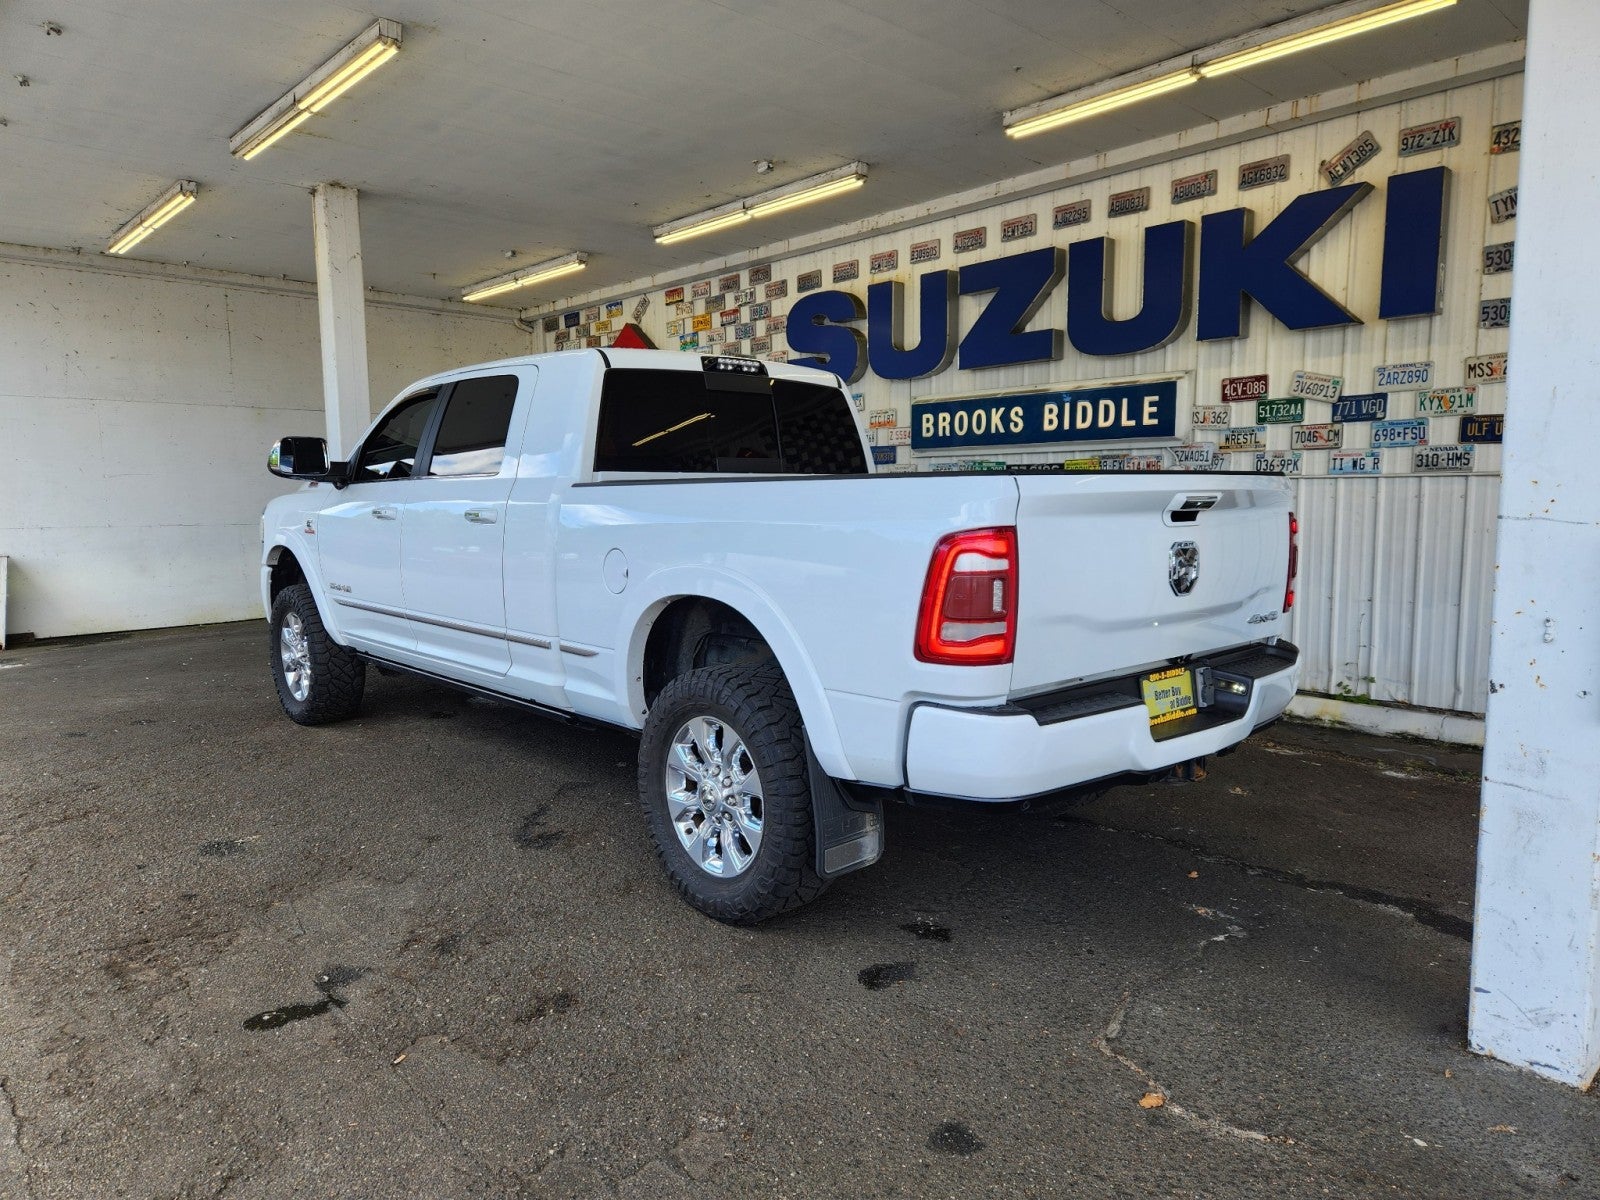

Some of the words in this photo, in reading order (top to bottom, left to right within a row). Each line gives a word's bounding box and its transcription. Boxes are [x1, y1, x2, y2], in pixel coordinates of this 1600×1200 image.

[1328, 139, 1375, 181] AEW1385
[786, 166, 1451, 383] SUZUKI
[1378, 369, 1428, 386] 2ARZ890
[1467, 361, 1494, 379] MSS
[1225, 381, 1266, 397] 4CV-086
[1293, 380, 1338, 398] 3V60913
[922, 406, 1024, 437] BROOKS
[1043, 395, 1159, 431] BIDDLE
[1259, 403, 1302, 418] 51732AA
[1295, 431, 1318, 444] 7046
[1327, 429, 1340, 442] CM
[1467, 422, 1490, 436] ULF
[1225, 432, 1260, 446] WRESTL
